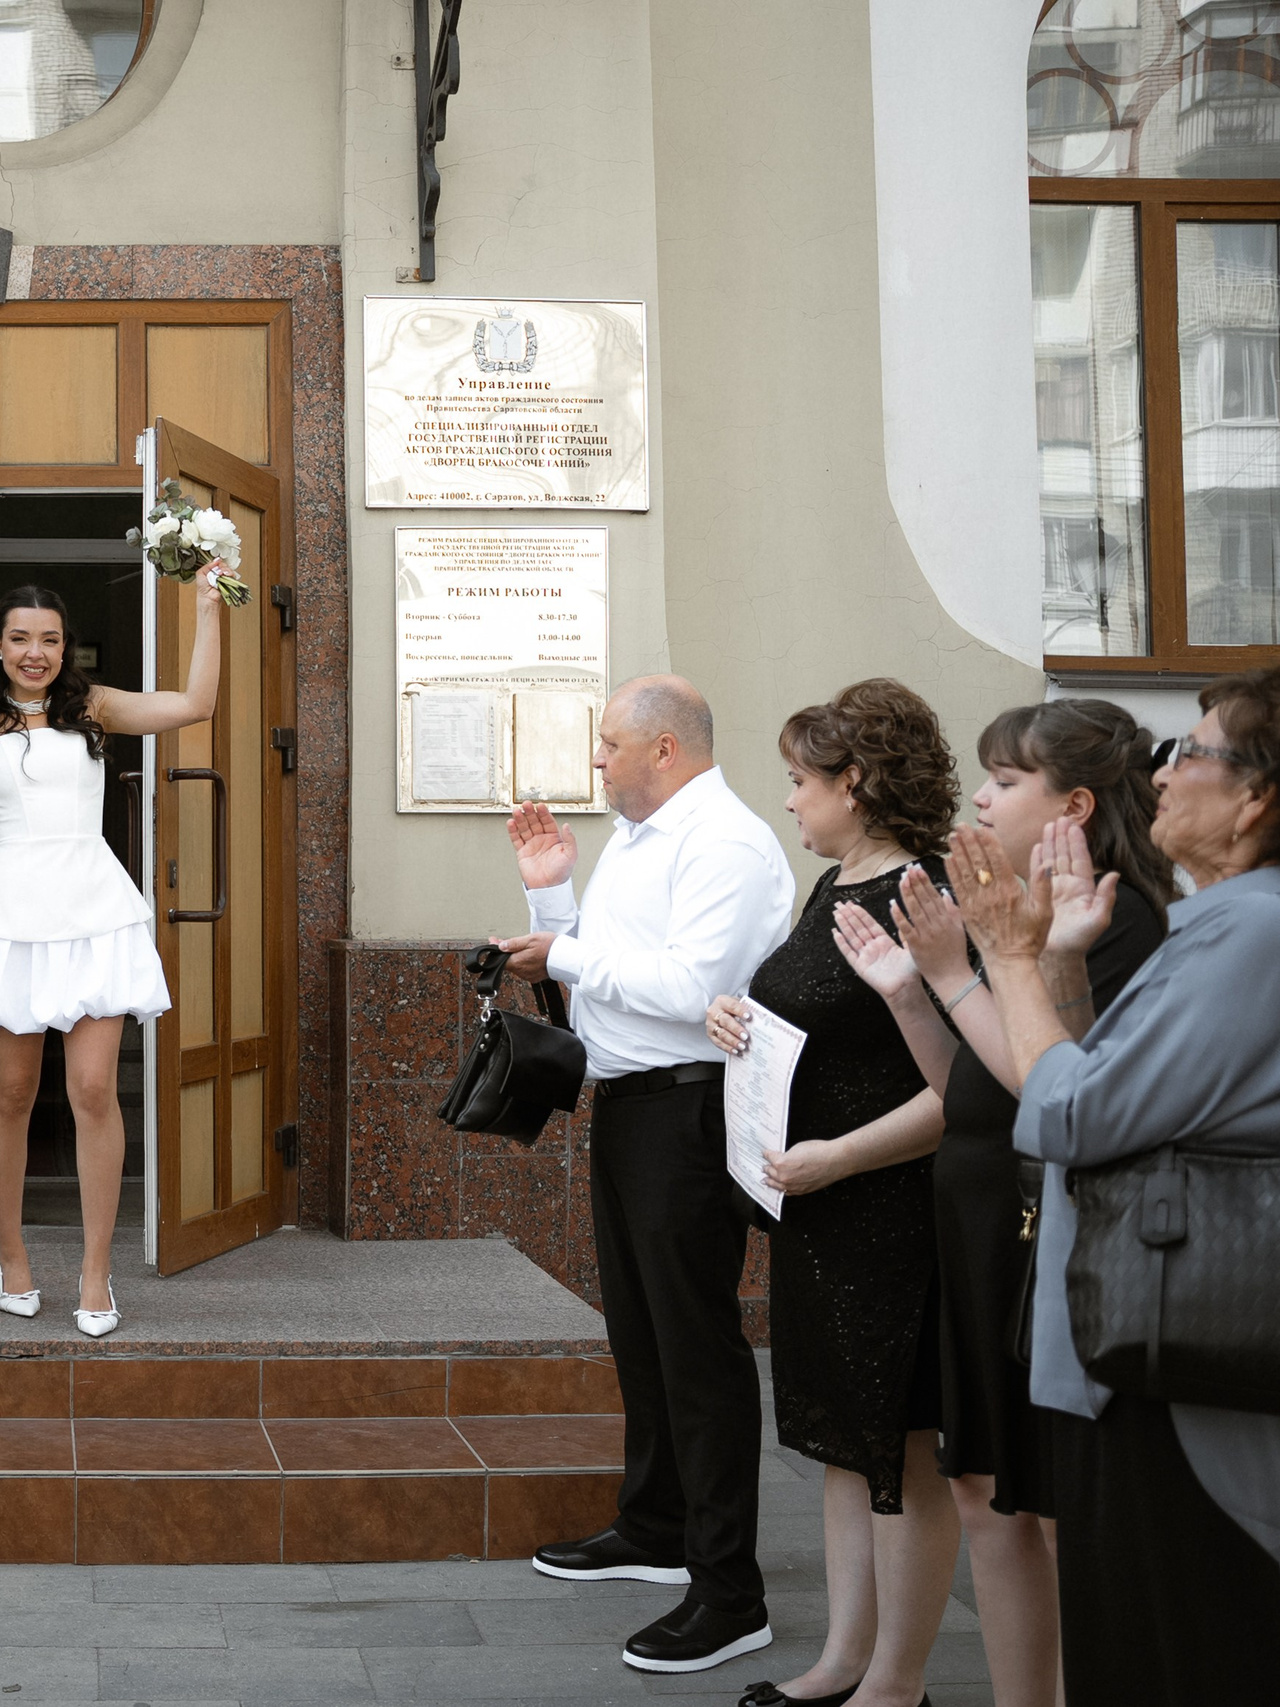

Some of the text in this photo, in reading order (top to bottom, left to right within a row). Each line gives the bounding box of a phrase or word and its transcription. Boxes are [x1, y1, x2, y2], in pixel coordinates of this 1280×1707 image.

[458, 378, 551, 391] Управление
[426, 405, 583, 414] Правительства Саратовской области
[414, 422, 599, 434] СПЕЦИАЛИЗИРОВАННЫЙ ОТДЕЛ
[408, 434, 608, 446] ГОСУДАРСТВЕННОЙ РЕГИСТРАЦИИ
[404, 446, 613, 457] АКТОВ ГРАЖДАНСКОГО СОСТОЯНИЯ
[424, 458, 591, 468] «ДВОРЕЦ БРАКОСОЧЕТАНИЙ»
[406, 493, 437, 501] Адрес:
[439, 493, 474, 501] 410002,
[484, 493, 526, 502] Саратов,
[544, 494, 593, 503] Волжская,
[595, 494, 606, 502] 22
[447, 587, 563, 598] РЕЖИМ РАБОТЫ
[405, 613, 440, 622] Вторник
[447, 613, 481, 623] Суббота
[538, 614, 578, 622] 8.30-17.30
[405, 633, 443, 642] Перерыв
[537, 634, 581, 642] 13.00-14.00
[405, 653, 459, 662] Воскресенье,
[538, 654, 581, 662] Выходные
